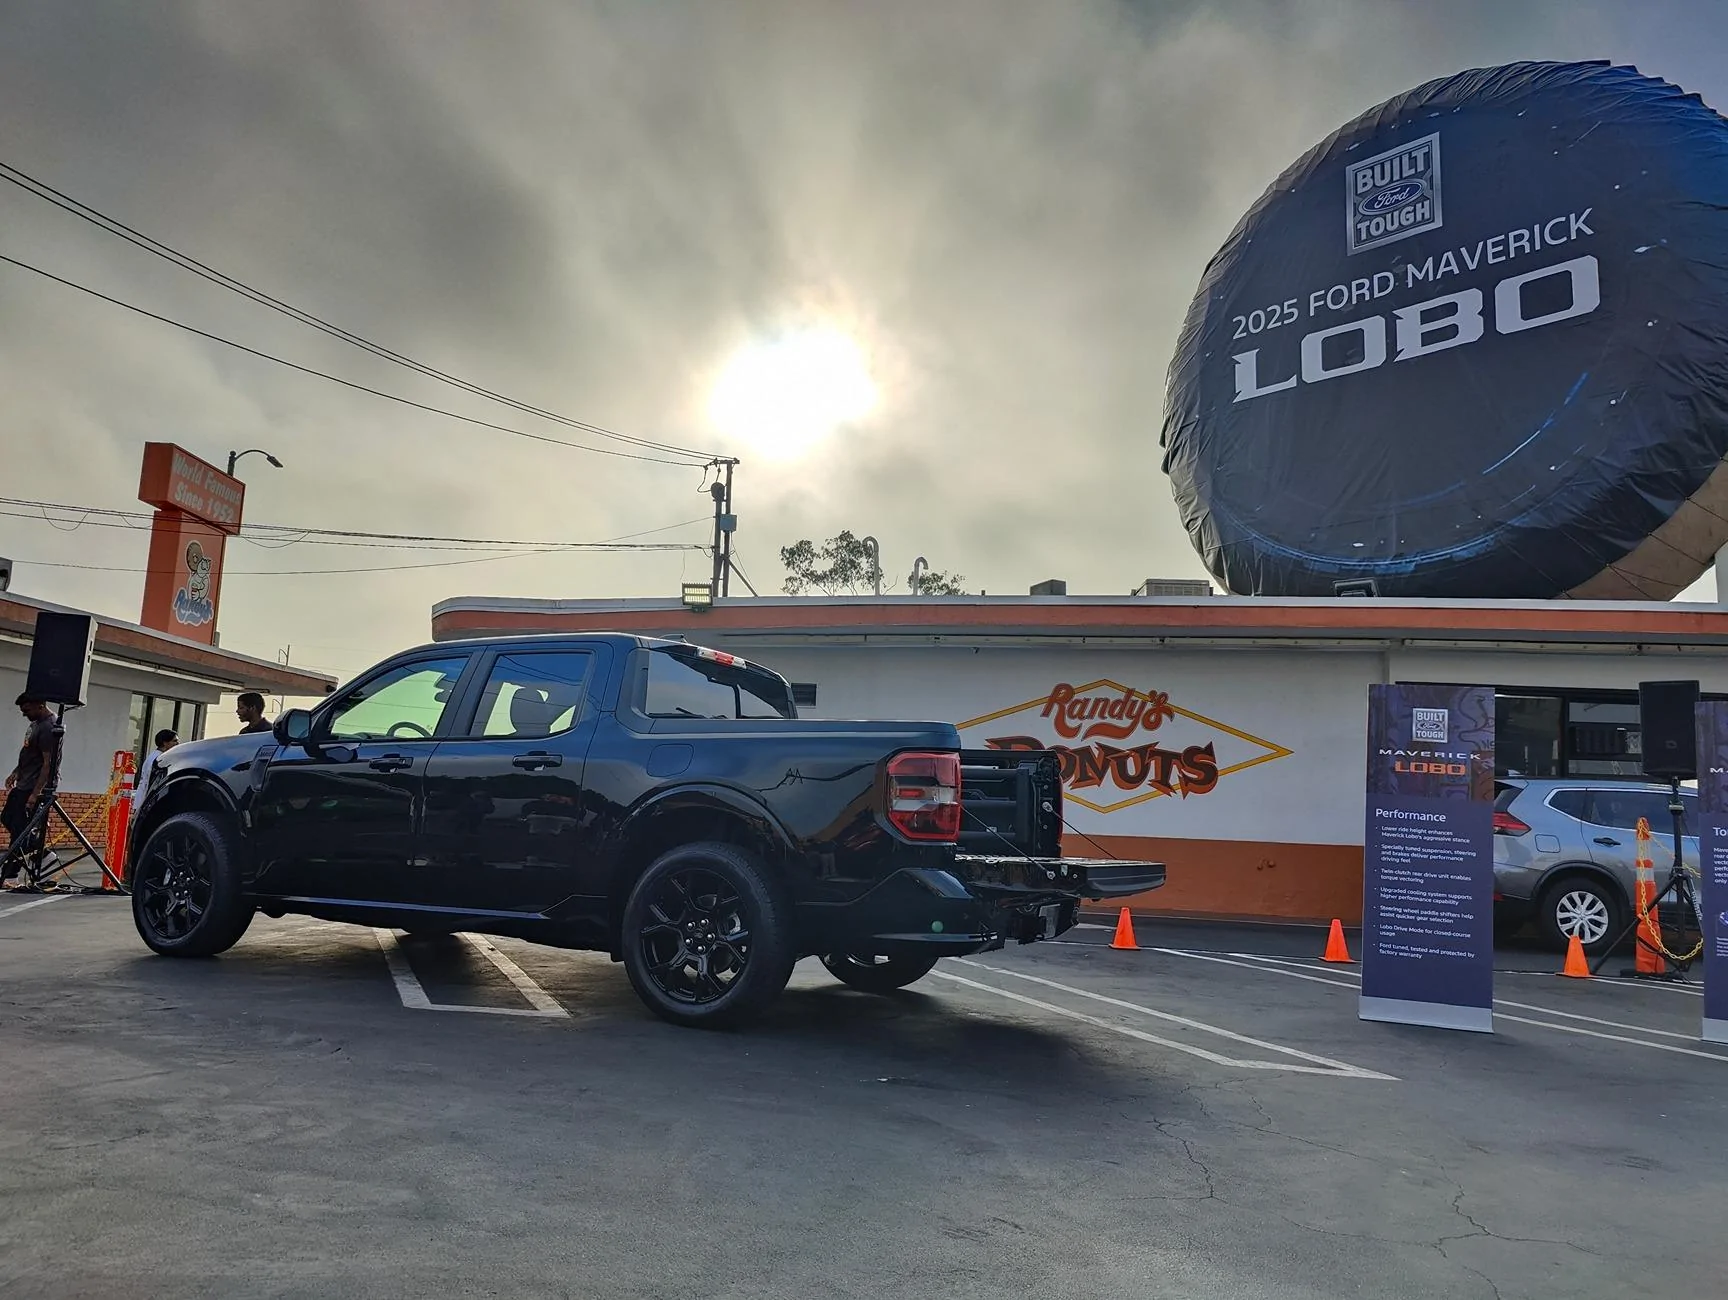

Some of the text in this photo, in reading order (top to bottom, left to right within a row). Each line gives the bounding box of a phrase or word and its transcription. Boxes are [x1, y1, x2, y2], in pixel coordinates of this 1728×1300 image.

[1356, 145, 1429, 194] BUILT
[1374, 187, 1410, 208] Ford
[1356, 199, 1431, 241] TOUGH
[1232, 208, 1597, 340] 2025 FORD MAVERICK
[1232, 255, 1601, 404] LOBO
[173, 454, 242, 505] World Famous
[174, 481, 203, 512] Since
[1040, 683, 1175, 741] Randy's
[1416, 712, 1445, 722] BUILT
[1416, 731, 1444, 739] TOUGH
[1379, 749, 1481, 760] MAVERICK
[1395, 761, 1466, 776] LOBO
[1375, 808, 1447, 822] Performance
[1430, 854, 1464, 862] performance
[1380, 905, 1402, 913] Steering
[1433, 898, 1459, 906] capability
[1399, 951, 1422, 959] warranty
[1440, 949, 1466, 957] protected
